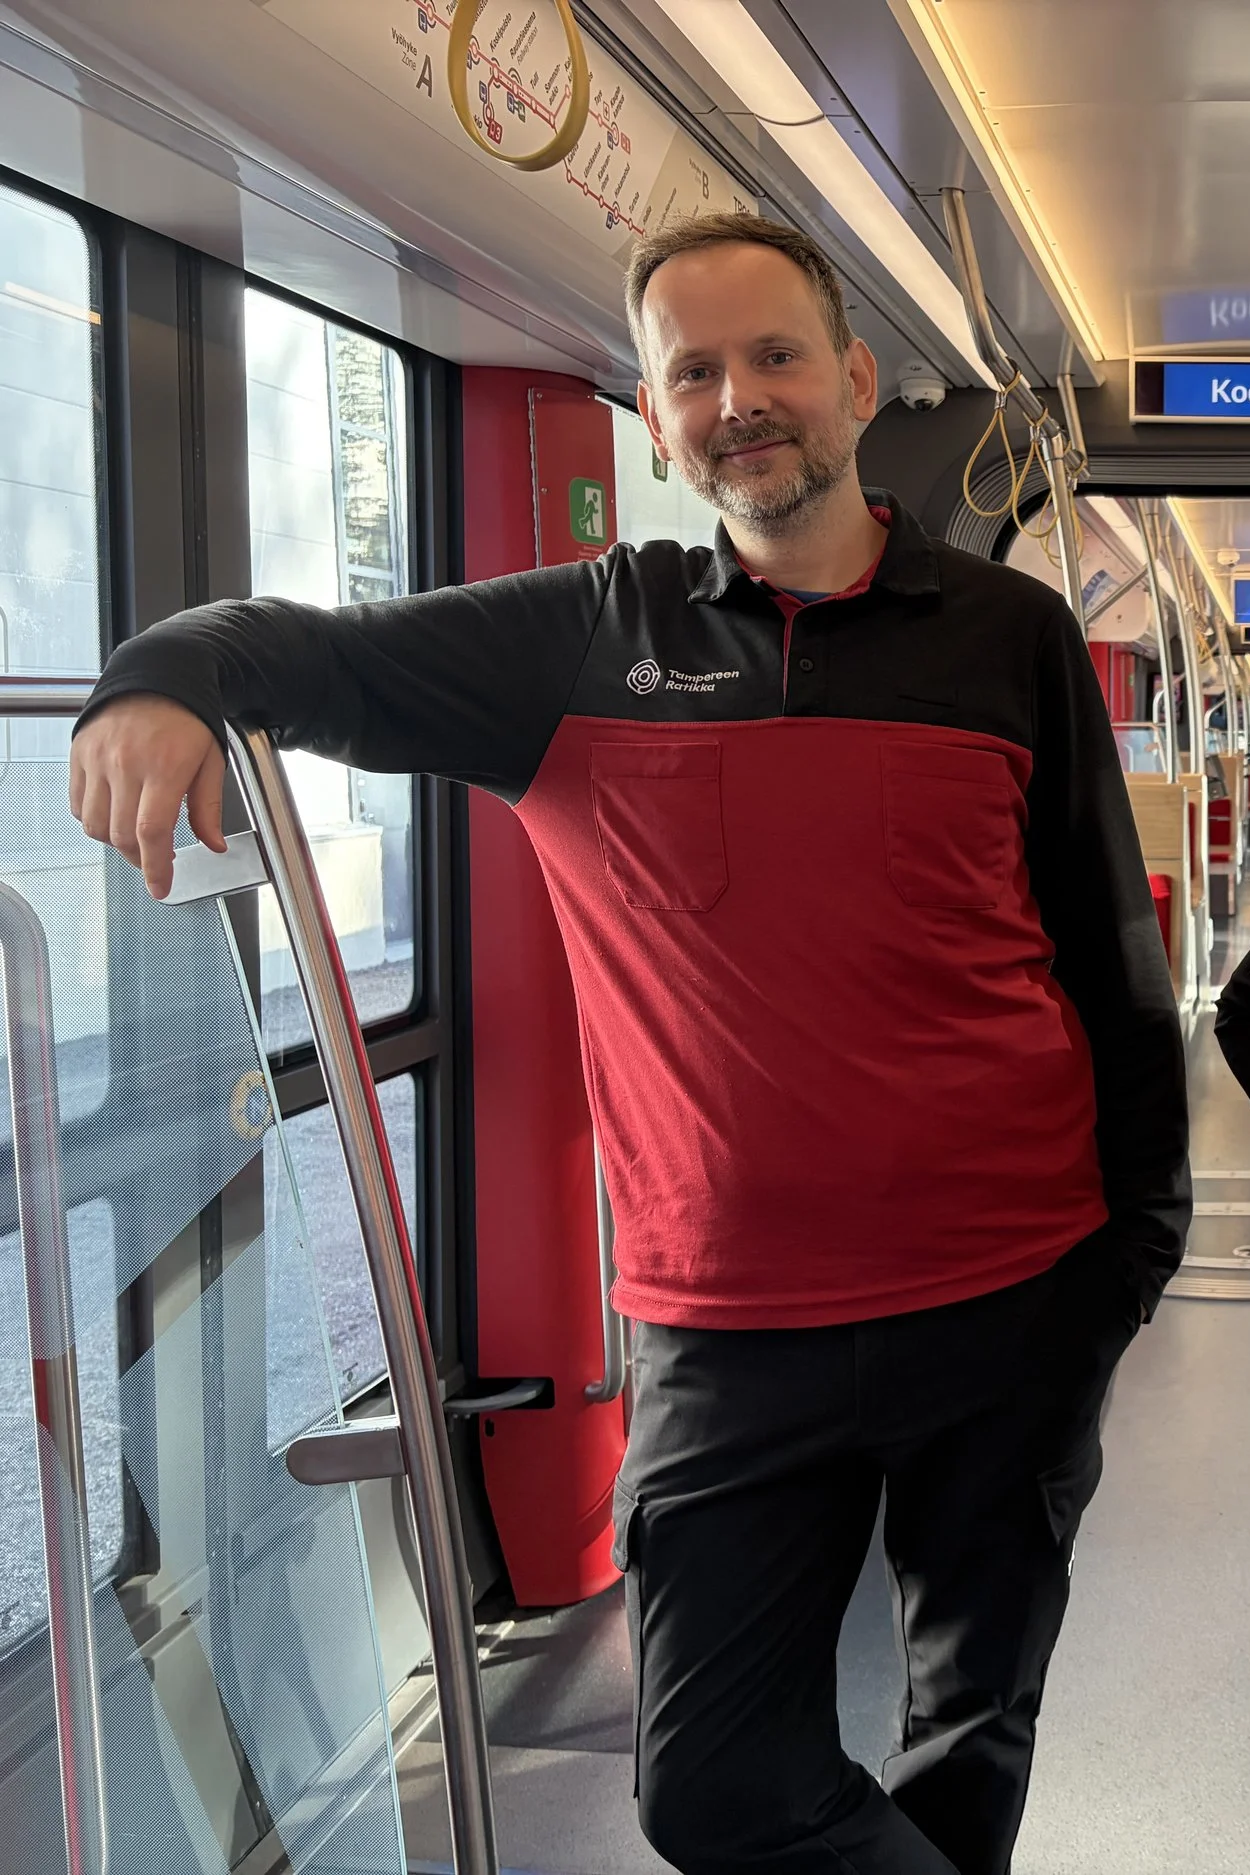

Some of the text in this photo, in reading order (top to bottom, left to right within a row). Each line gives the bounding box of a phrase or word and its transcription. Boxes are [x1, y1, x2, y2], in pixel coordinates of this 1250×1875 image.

[391, 27, 418, 56] Vyöhyke
[489, 13, 512, 52] Koskipuisto
[401, 52, 417, 71] Zone
[416, 54, 433, 98] A
[702, 170, 709, 200] B
[665, 680, 716, 692] Ratikka
[668, 669, 740, 683] Tampereen
